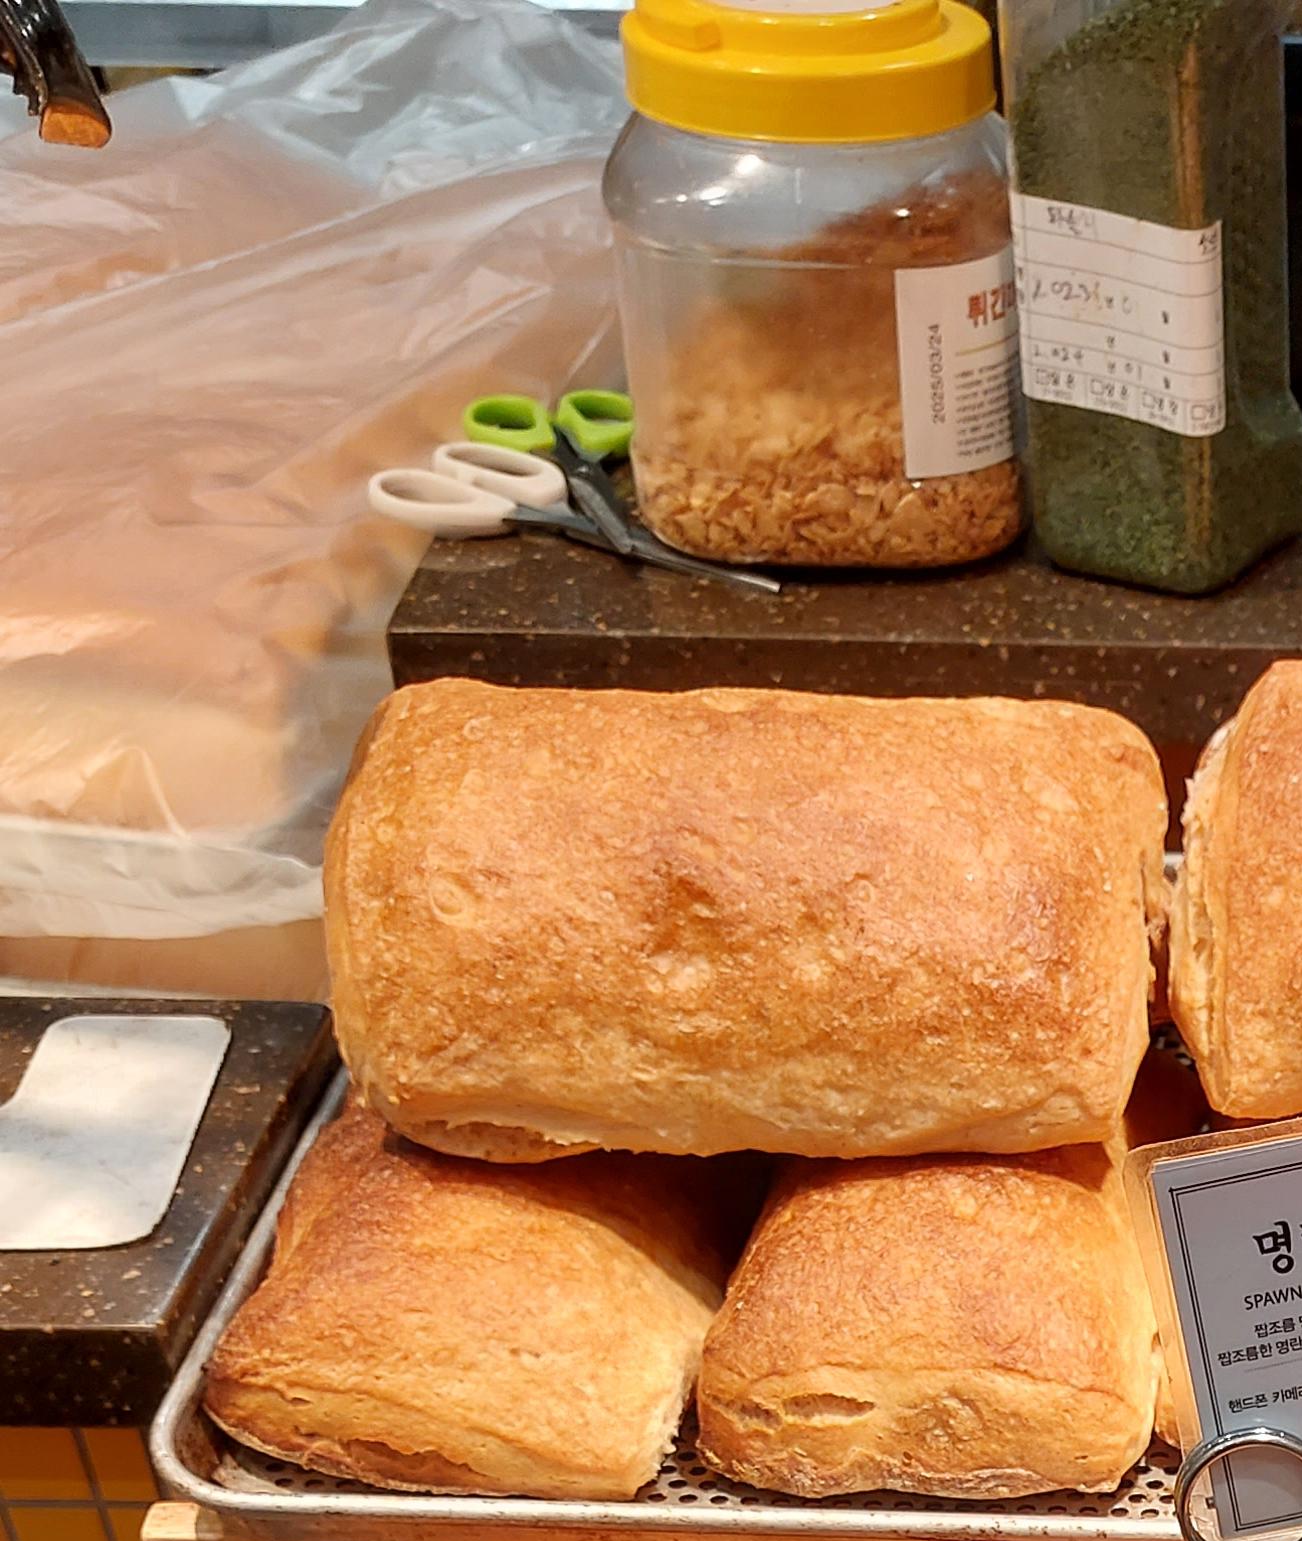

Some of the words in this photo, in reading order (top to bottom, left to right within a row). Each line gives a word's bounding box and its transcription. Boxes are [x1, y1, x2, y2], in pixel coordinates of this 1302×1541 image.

[927, 323, 945, 424] 2025/03/24
[1254, 1313, 1296, 1339] 짭조름
[1217, 1343, 1274, 1367] 짭조름한
[1228, 1394, 1269, 1414] 핸드폰
